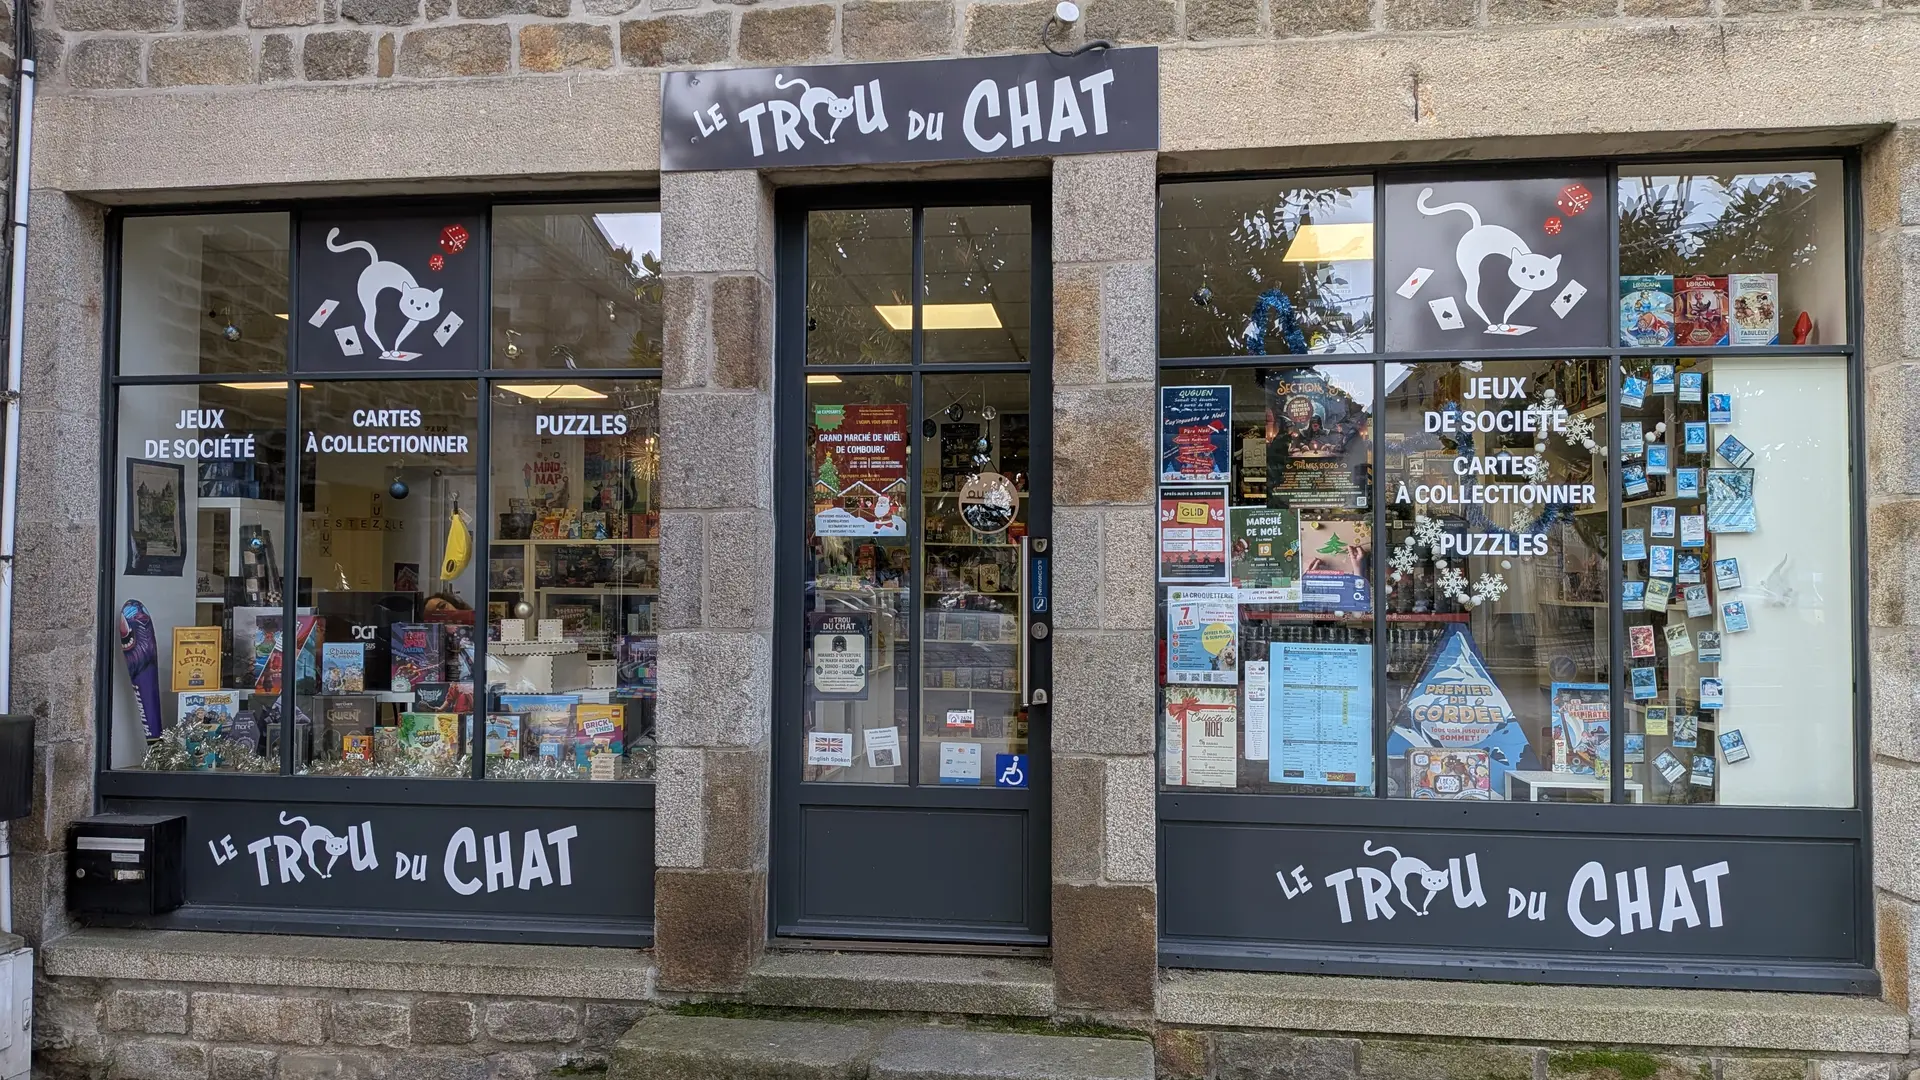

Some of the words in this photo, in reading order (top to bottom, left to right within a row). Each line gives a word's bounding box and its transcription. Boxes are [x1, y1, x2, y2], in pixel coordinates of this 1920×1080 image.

[693, 102, 727, 138] LE
[908, 109, 943, 142] DU
[962, 69, 1115, 153] CHAT
[1464, 377, 1526, 399] JEUX
[175, 409, 225, 429] JEUX
[352, 409, 421, 427] CARTES
[536, 414, 627, 435] PUZZLES
[1424, 411, 1456, 432] DE
[305, 431, 319, 453] À
[321, 435, 469, 453] COLLECTIONNER
[819, 433, 843, 442] GRAND
[844, 431, 871, 442] MARCHÉ
[873, 433, 882, 442] DE
[884, 431, 903, 442] NOËL
[145, 439, 170, 459] DE
[172, 433, 255, 459] SOCIÉTÉ
[836, 446, 845, 454] DE
[847, 445, 886, 454] COMBOURG
[1453, 456, 1537, 475] CARTES
[535, 473, 562, 485] MAP
[1395, 481, 1411, 504] À
[1415, 484, 1596, 504] COLLECTIONNER
[1246, 513, 1282, 526] MARCHÉ
[1246, 528, 1257, 536] DE
[1260, 526, 1283, 536] NOËL
[1260, 545, 1270, 554] 19
[1440, 533, 1548, 556] PUZZLES
[1180, 607, 1190, 619] 7
[352, 625, 378, 640] DGT
[835, 622, 857, 630] CHAT
[197, 647, 207, 656] LA
[1425, 684, 1492, 697] PREMIER
[1449, 696, 1466, 704] DE
[327, 709, 361, 722] GWENT
[1188, 711, 1224, 723] Collecte
[1224, 714, 1236, 723] de
[1414, 698, 1505, 724] CORDÉE
[585, 720, 608, 728] BRICK
[345, 752, 365, 760] ZERO
[348, 746, 364, 754] UNO
[208, 834, 238, 866] LE
[395, 851, 427, 882] DU
[443, 825, 578, 895] CHAT
[1275, 864, 1313, 900] LE
[1507, 887, 1547, 921] DU
[1567, 860, 1730, 938] CHAT
